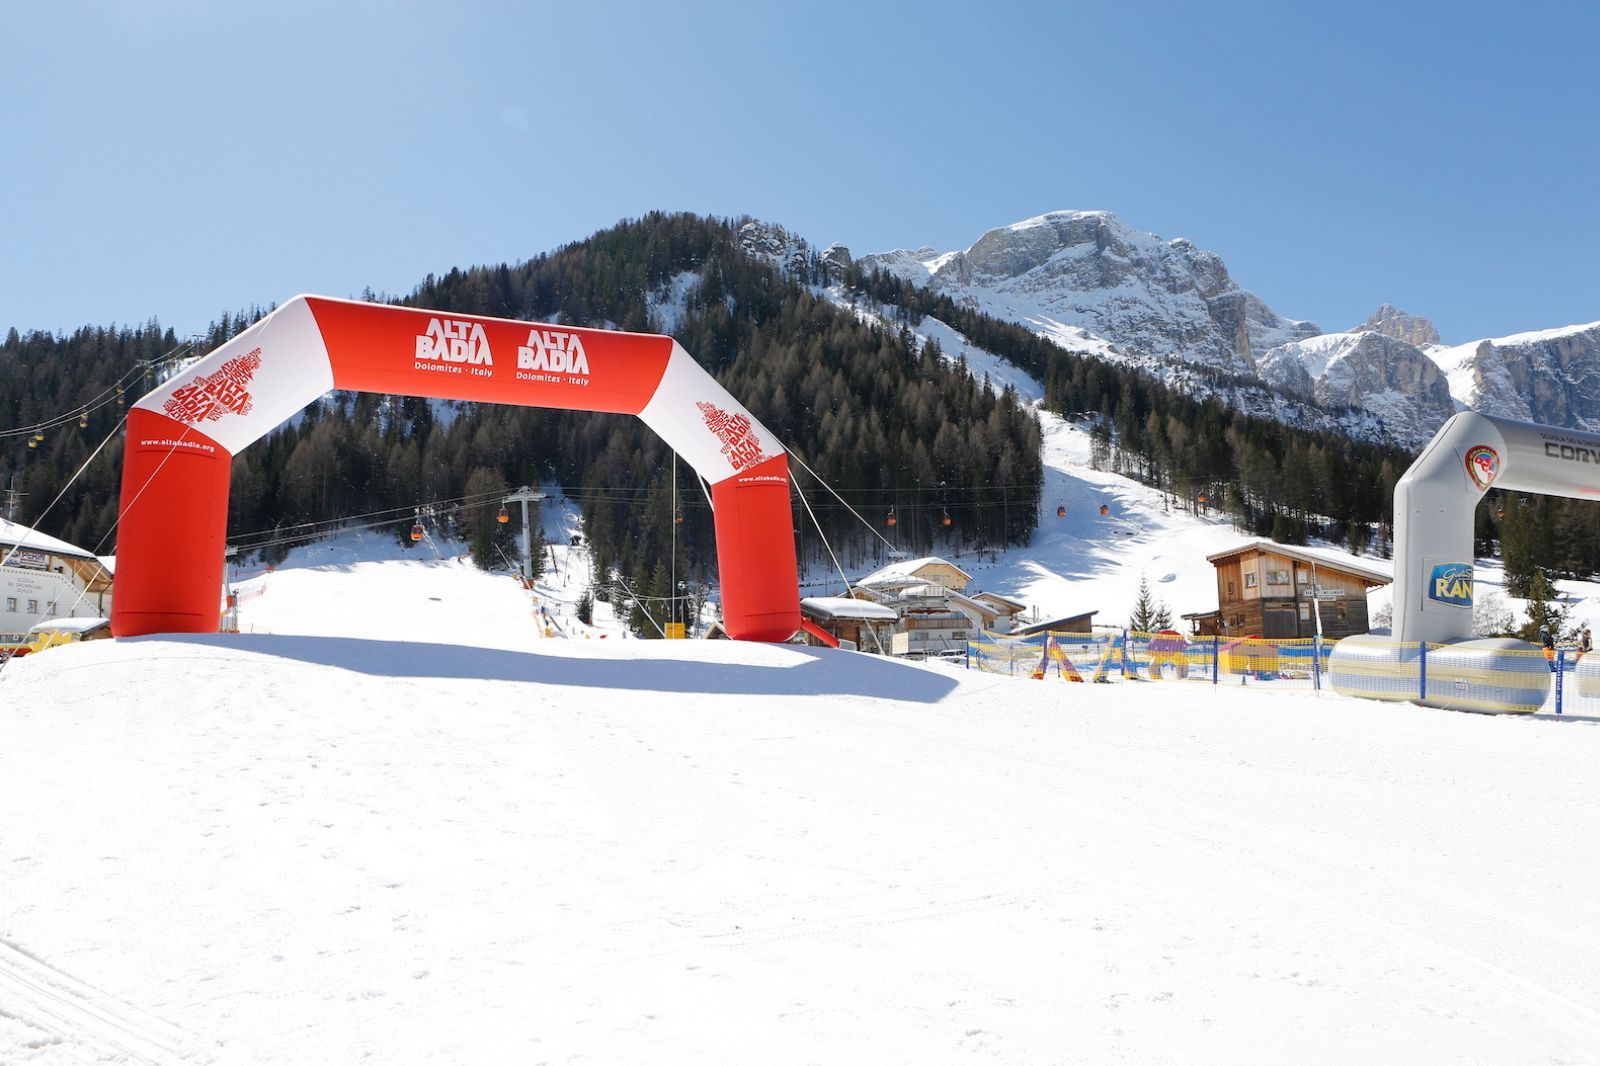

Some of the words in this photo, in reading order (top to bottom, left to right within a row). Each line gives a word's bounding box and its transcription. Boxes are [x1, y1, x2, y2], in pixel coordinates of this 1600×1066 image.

[425, 318, 488, 342] ALTA
[526, 329, 586, 352] ALTA
[415, 334, 494, 366] BADIA
[517, 345, 590, 375] BADIA
[414, 361, 463, 374] Dolomites
[471, 367, 493, 378] Italy
[516, 371, 561, 383] Dolomites
[568, 377, 589, 387] Italy
[140, 439, 215, 453] www.altabadia.org
